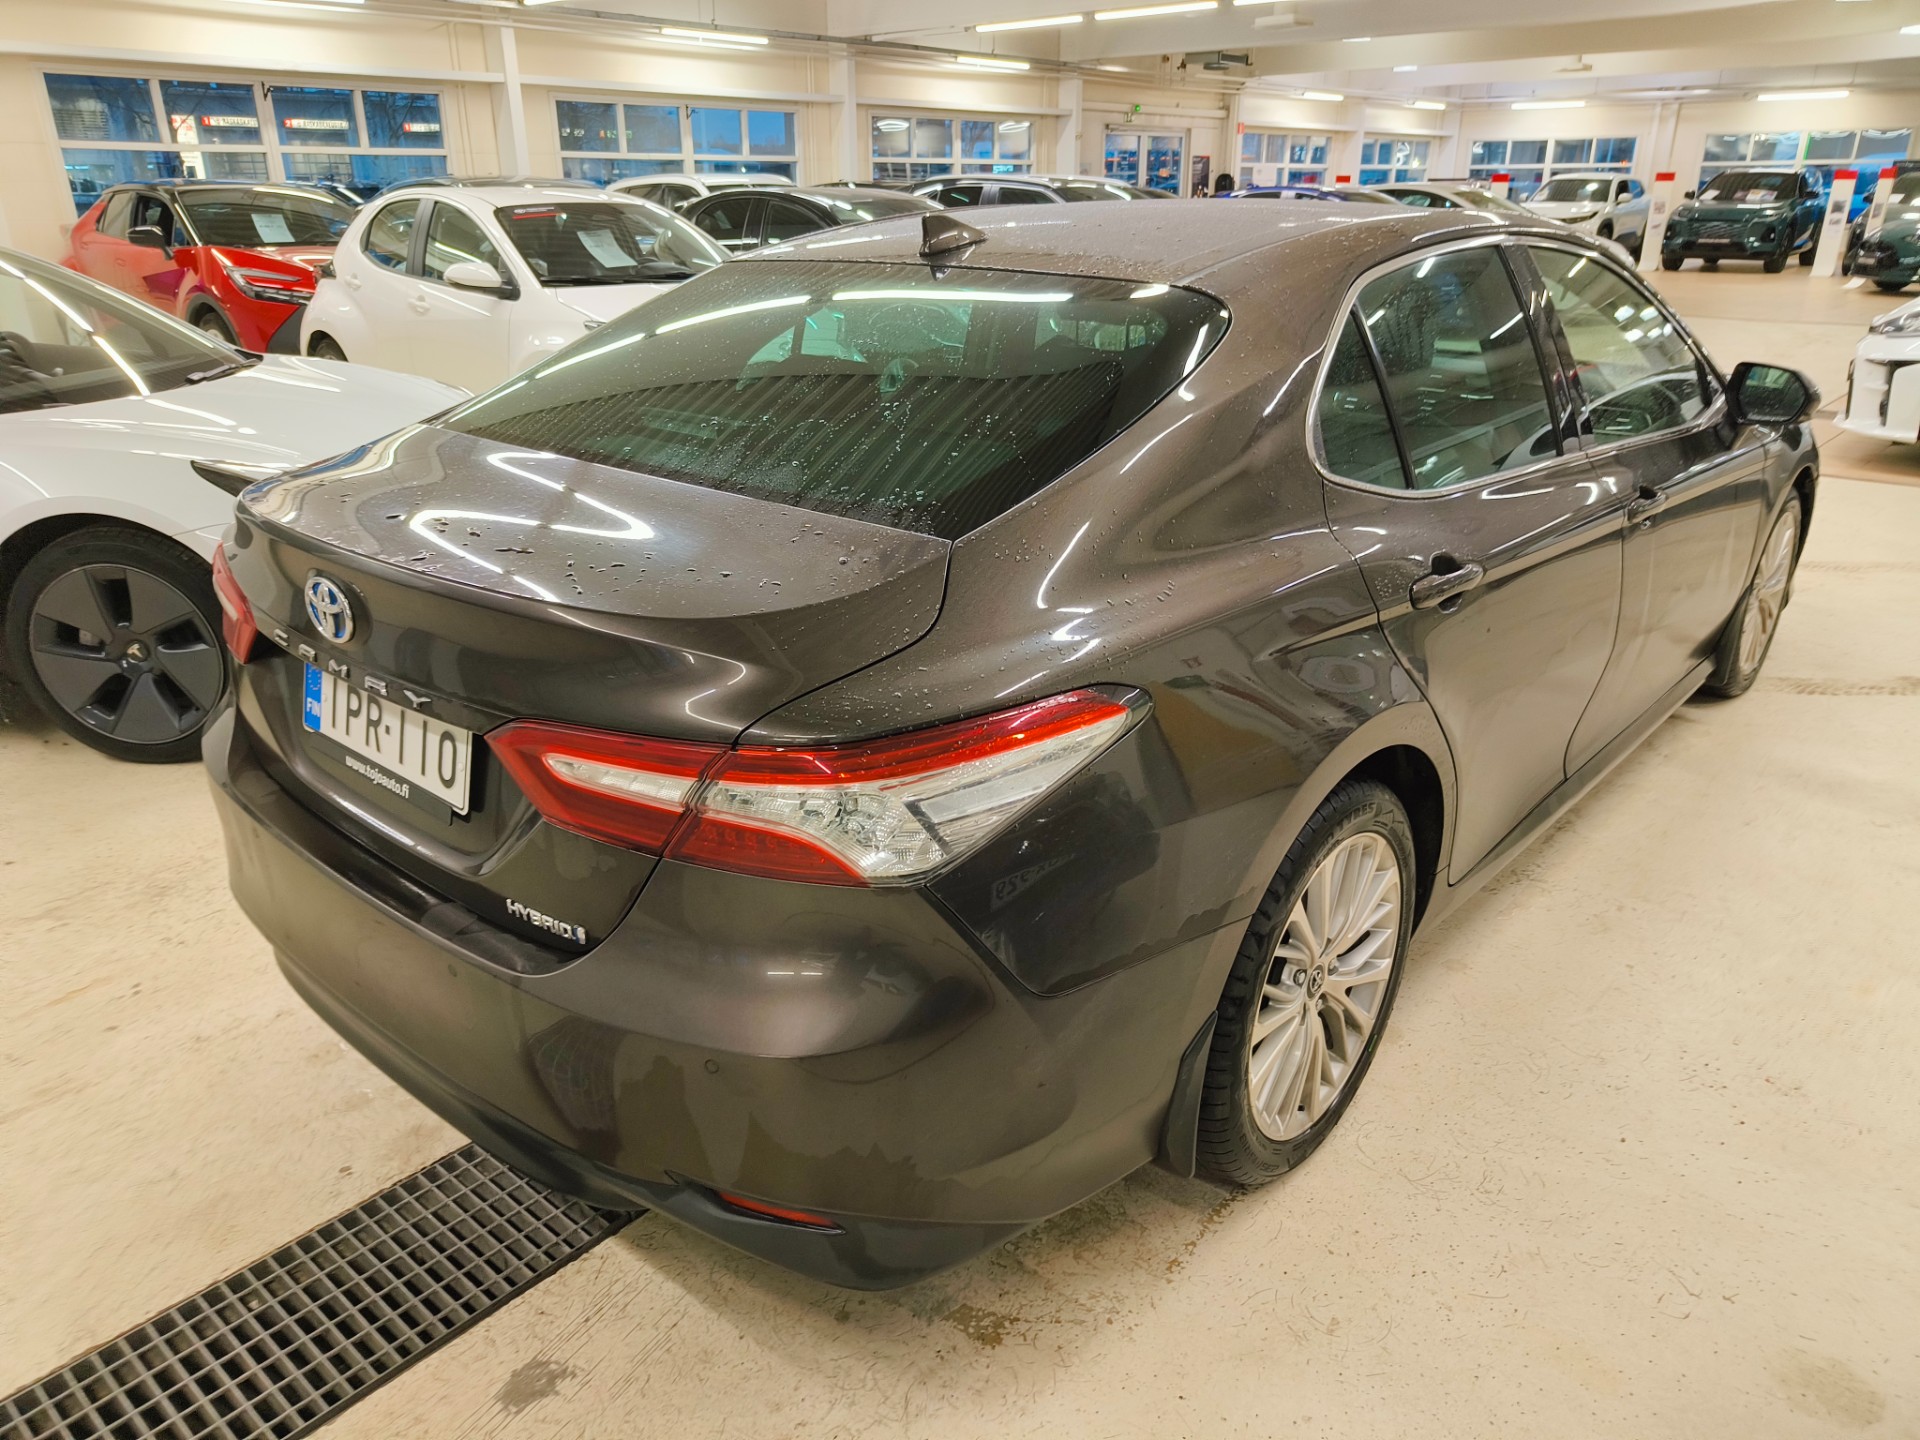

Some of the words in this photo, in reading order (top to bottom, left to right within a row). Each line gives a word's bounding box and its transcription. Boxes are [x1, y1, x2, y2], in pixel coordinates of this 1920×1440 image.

[273, 628, 432, 709] CAMRY
[306, 697, 321, 718] FIN
[345, 755, 410, 799] www.tojoauto.fi
[505, 898, 573, 940] HYBRID
